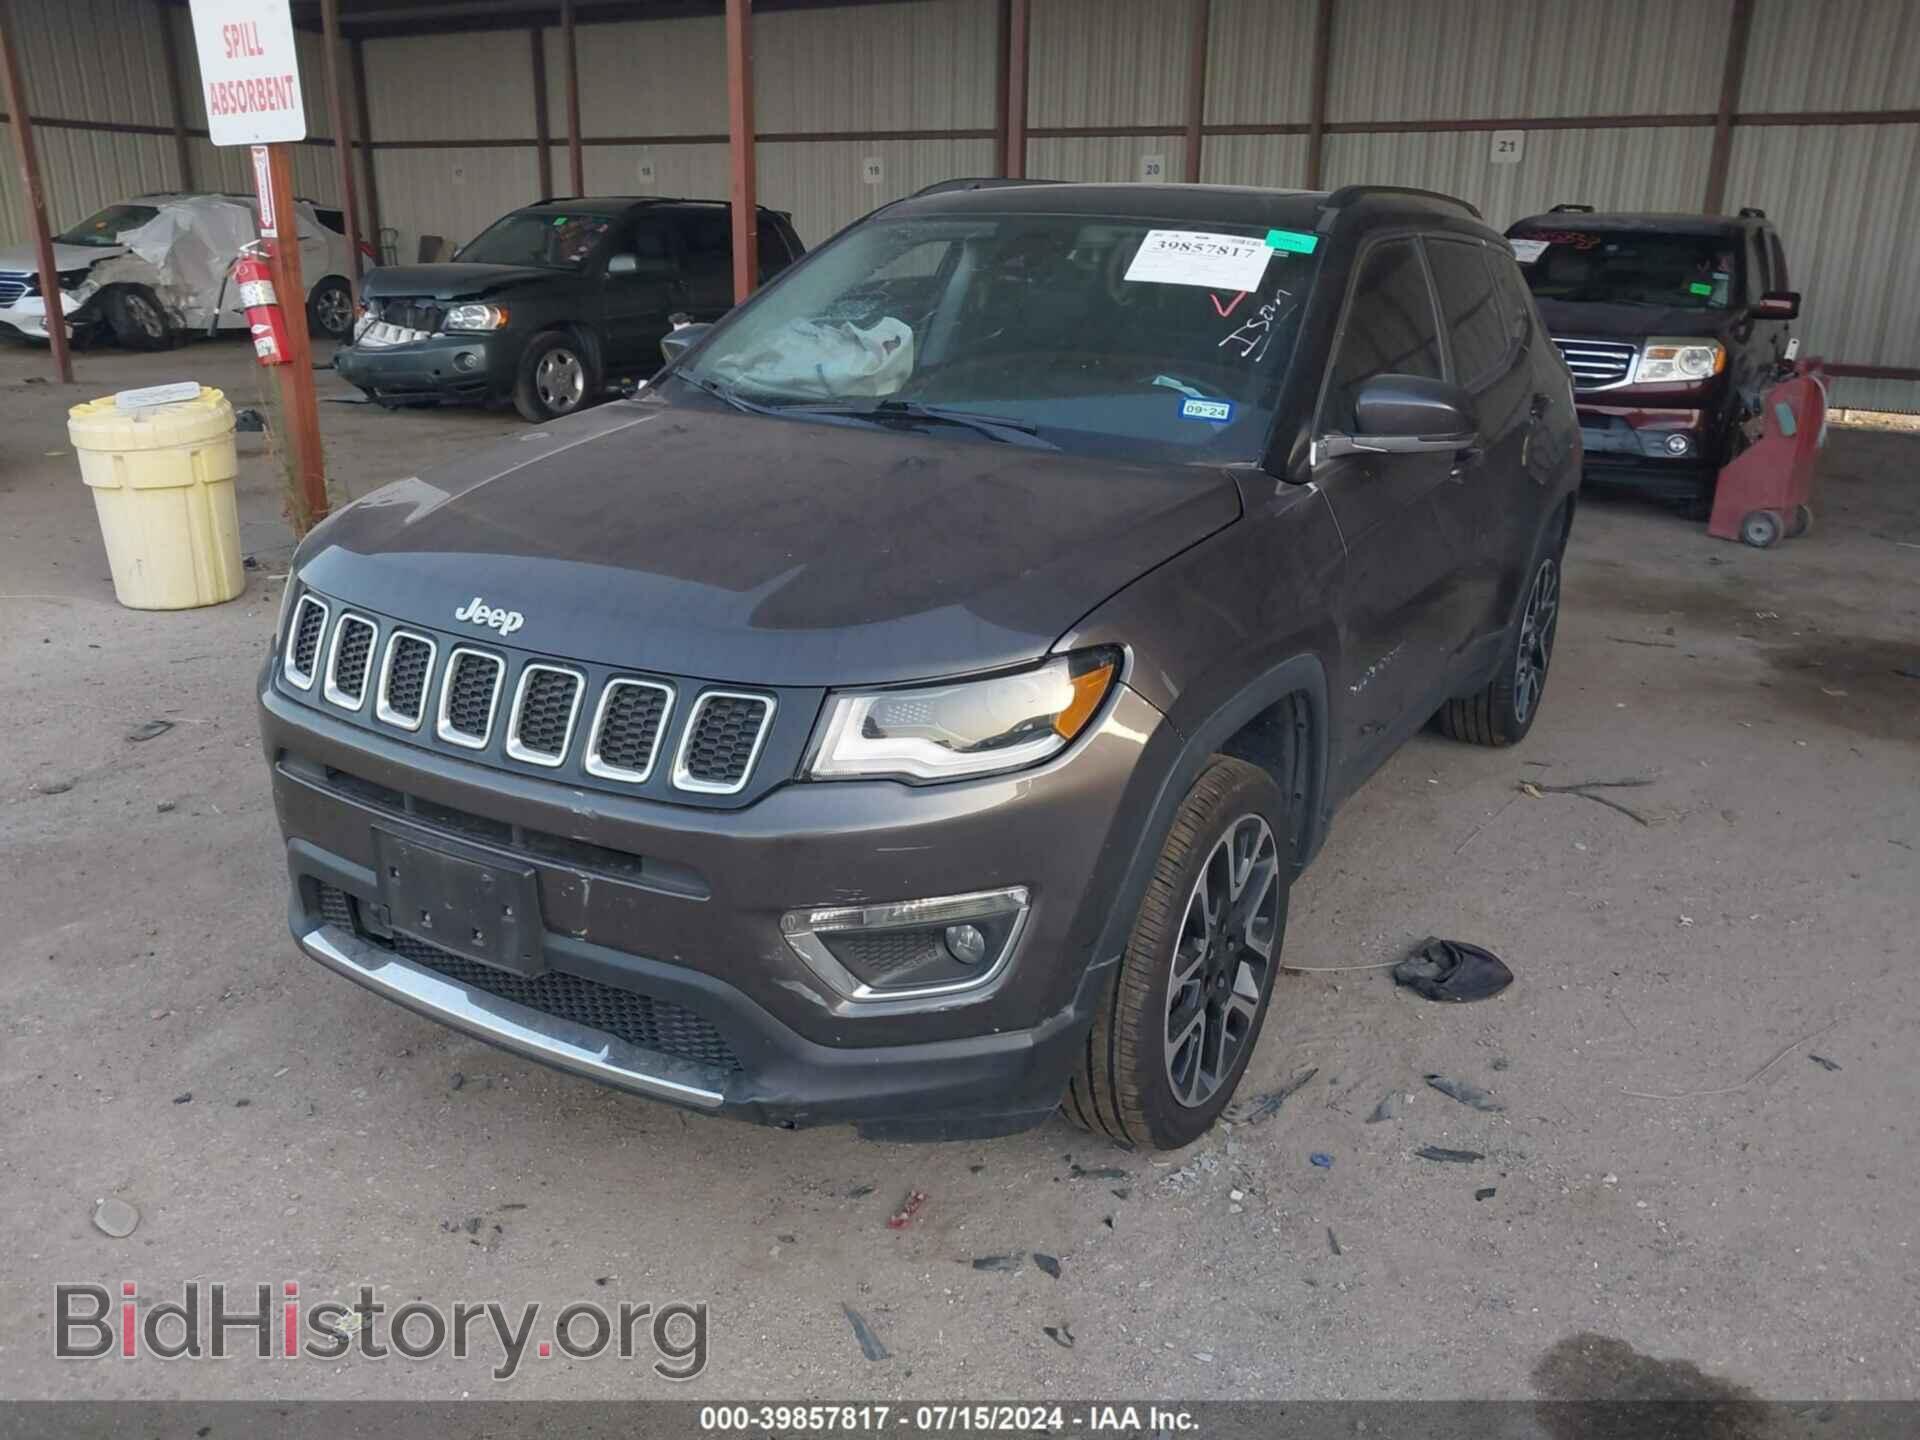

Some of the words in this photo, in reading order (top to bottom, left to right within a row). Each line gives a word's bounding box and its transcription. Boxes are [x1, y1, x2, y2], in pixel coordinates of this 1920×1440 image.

[222, 20, 264, 59] SPILL
[209, 74, 295, 116] ABSORBENT
[1499, 140, 1516, 153] 21
[1146, 164, 1161, 176] 20
[1158, 240, 1256, 258] 39857817
[455, 597, 524, 636] Jeep
